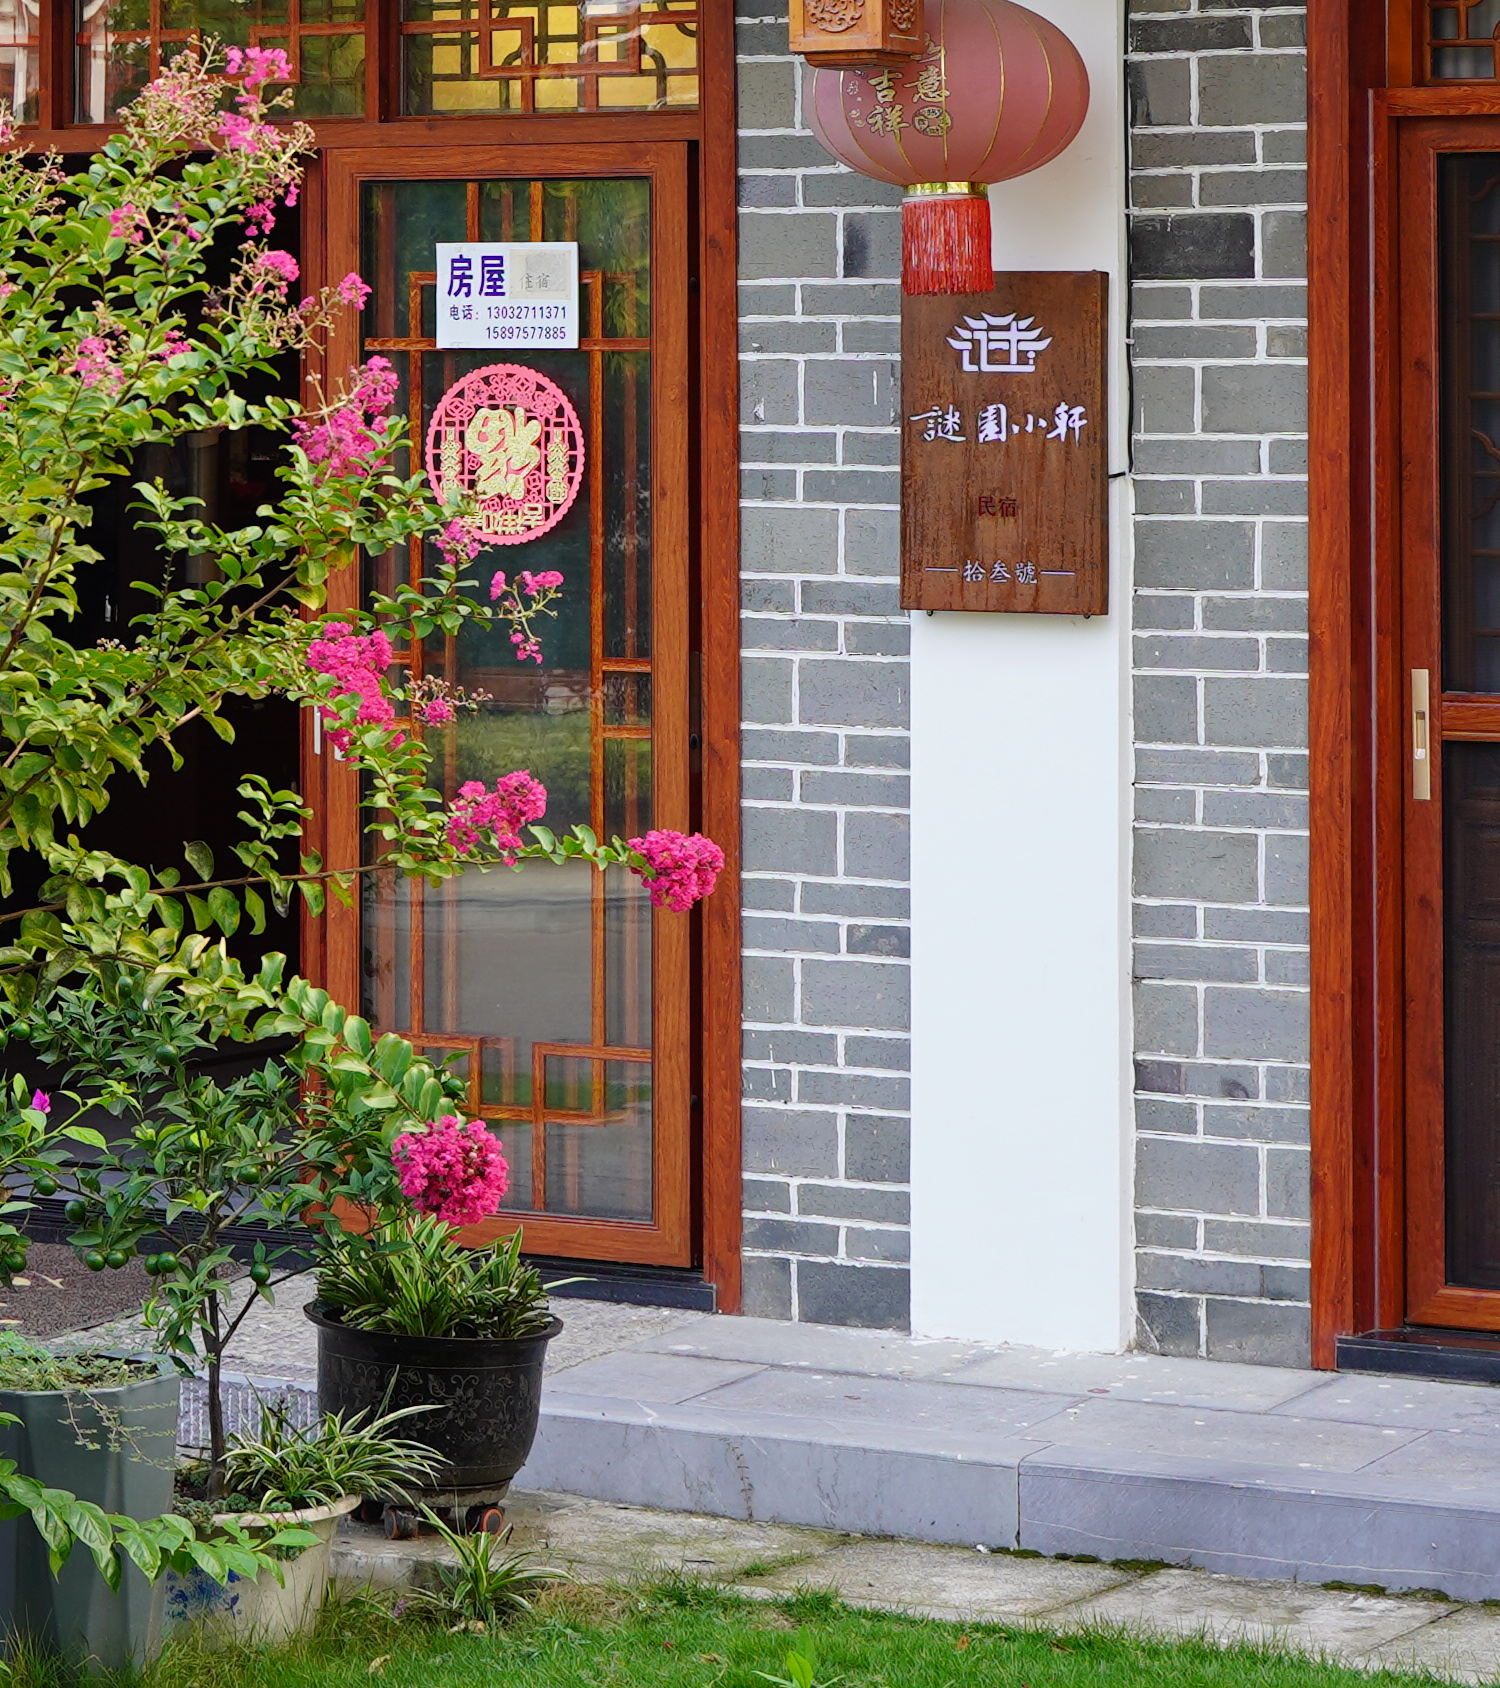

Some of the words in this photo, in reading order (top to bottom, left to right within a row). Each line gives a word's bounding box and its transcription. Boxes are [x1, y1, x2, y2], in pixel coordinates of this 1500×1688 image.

[447, 254, 506, 298] 房屋
[486, 306, 567, 320] 13032711371
[485, 326, 566, 340] 15897577885
[977, 495, 1018, 518] 民宿
